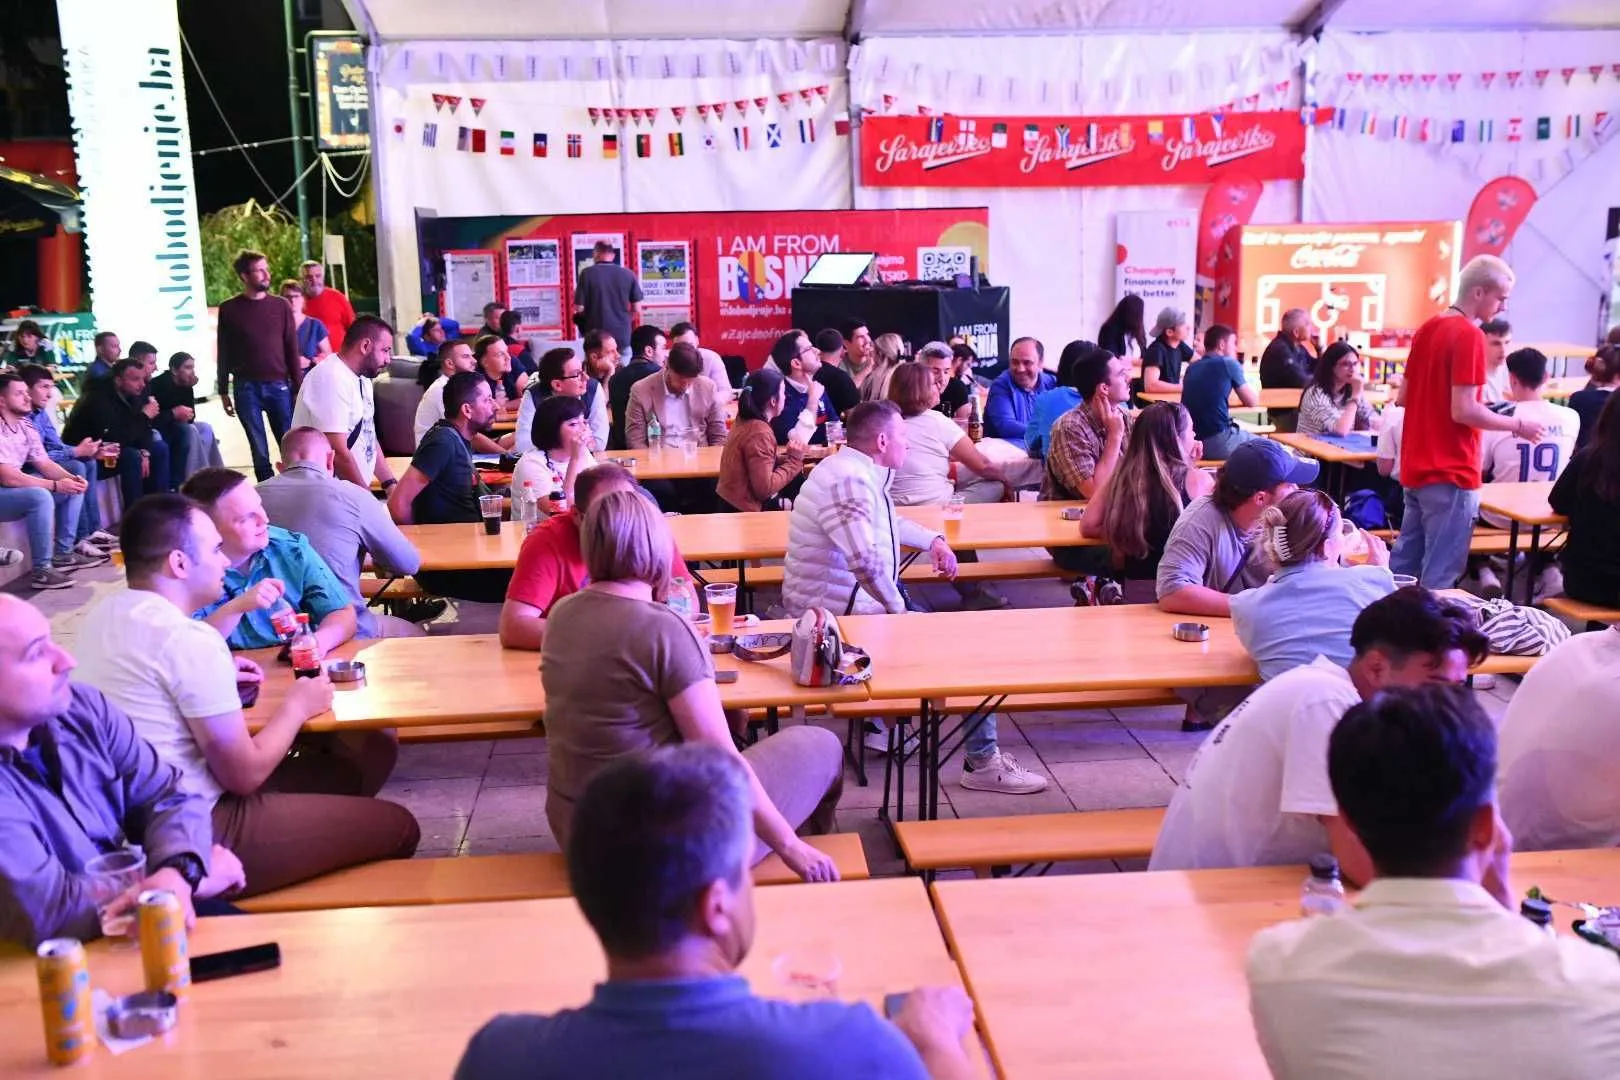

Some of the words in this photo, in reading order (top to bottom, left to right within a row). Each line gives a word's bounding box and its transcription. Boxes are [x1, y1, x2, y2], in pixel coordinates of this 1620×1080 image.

[139, 47, 194, 332] oslobodjenje.ba
[730, 235, 766, 254] AM
[773, 234, 840, 253] FROM
[1124, 278, 1169, 286] finances
[1171, 278, 1186, 286] for
[973, 323, 998, 335] FROM
[1516, 443, 1559, 482] 19
